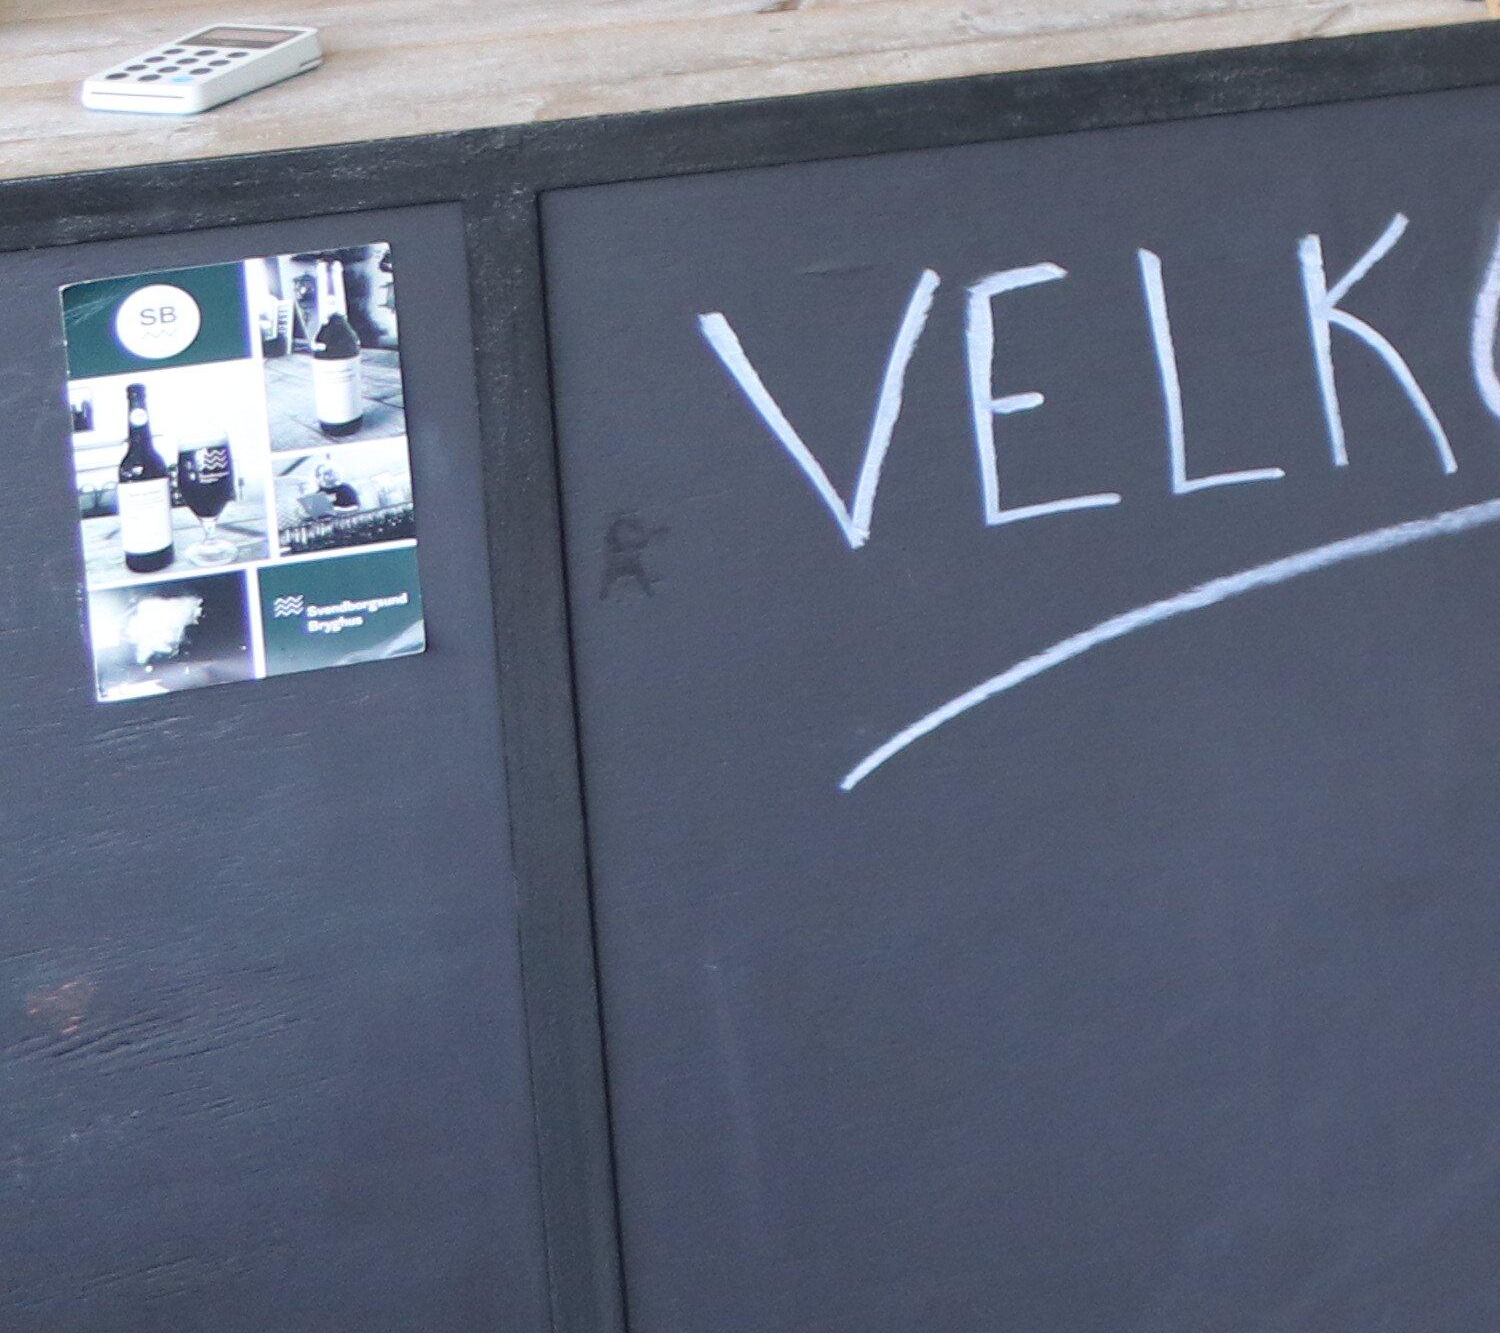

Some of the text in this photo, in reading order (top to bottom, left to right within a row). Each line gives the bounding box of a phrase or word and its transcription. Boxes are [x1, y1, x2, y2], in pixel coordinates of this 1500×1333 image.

[140, 305, 177, 327] SB
[307, 592, 409, 619] Svendborgsund
[308, 614, 364, 634] Bryghus
